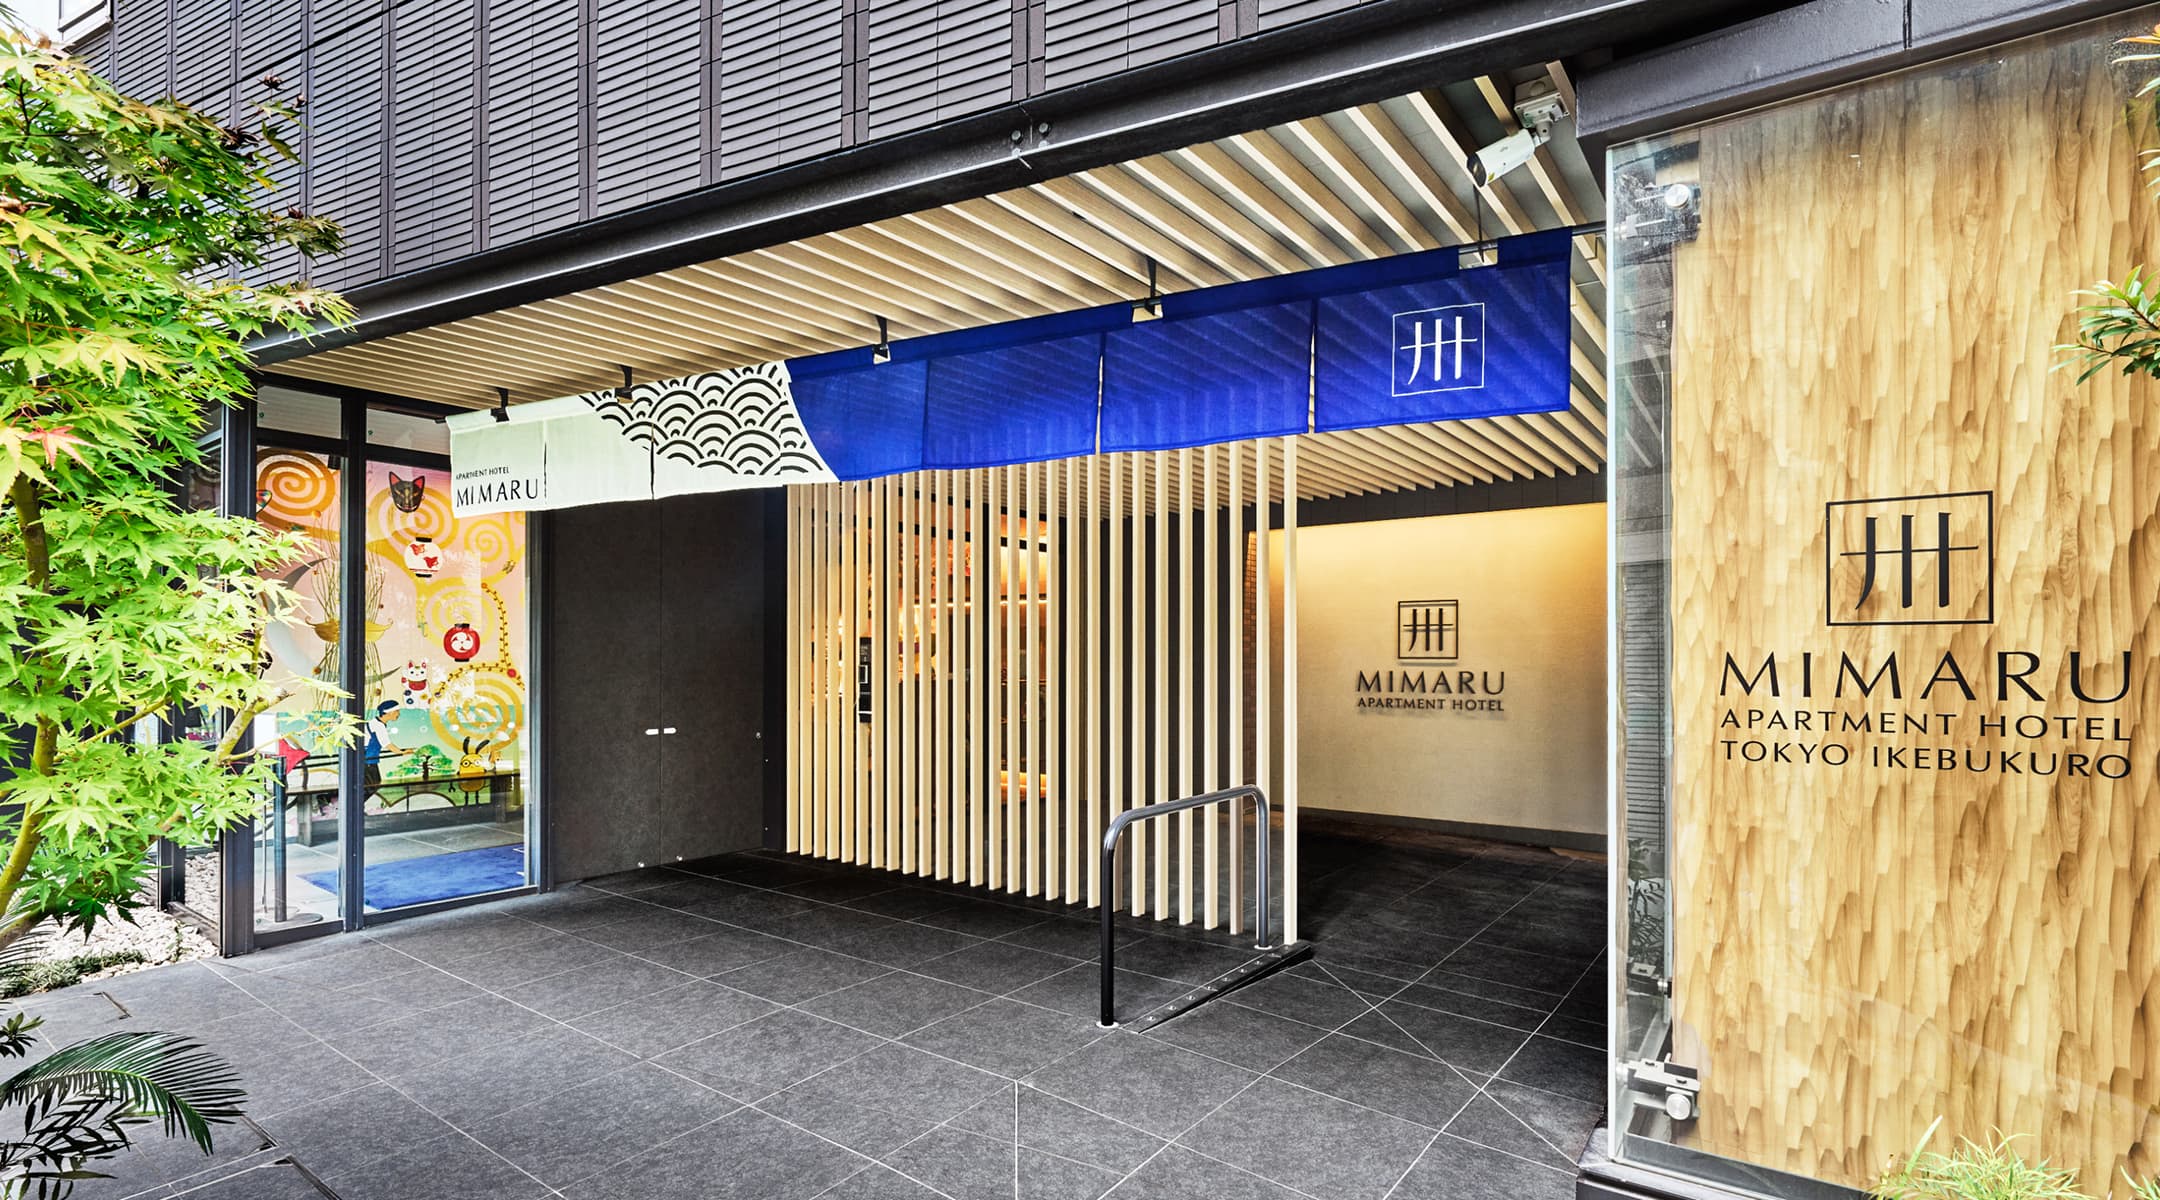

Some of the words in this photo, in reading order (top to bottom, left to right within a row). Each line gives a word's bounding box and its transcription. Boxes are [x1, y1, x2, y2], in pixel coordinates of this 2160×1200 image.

[489, 466, 510, 476] HOTEL
[456, 478, 539, 507] MIMARU
[1357, 670, 1505, 695] MIMARU
[1720, 651, 2132, 704] MIMARU
[1357, 697, 1446, 710] APARTMENT
[1452, 699, 1505, 712] HOTEL
[1720, 708, 1958, 736] APARTMENT
[1979, 714, 2132, 742] HOTEL
[1720, 740, 1850, 766] TOKYO
[1872, 746, 2133, 780] IKEBUKURO
